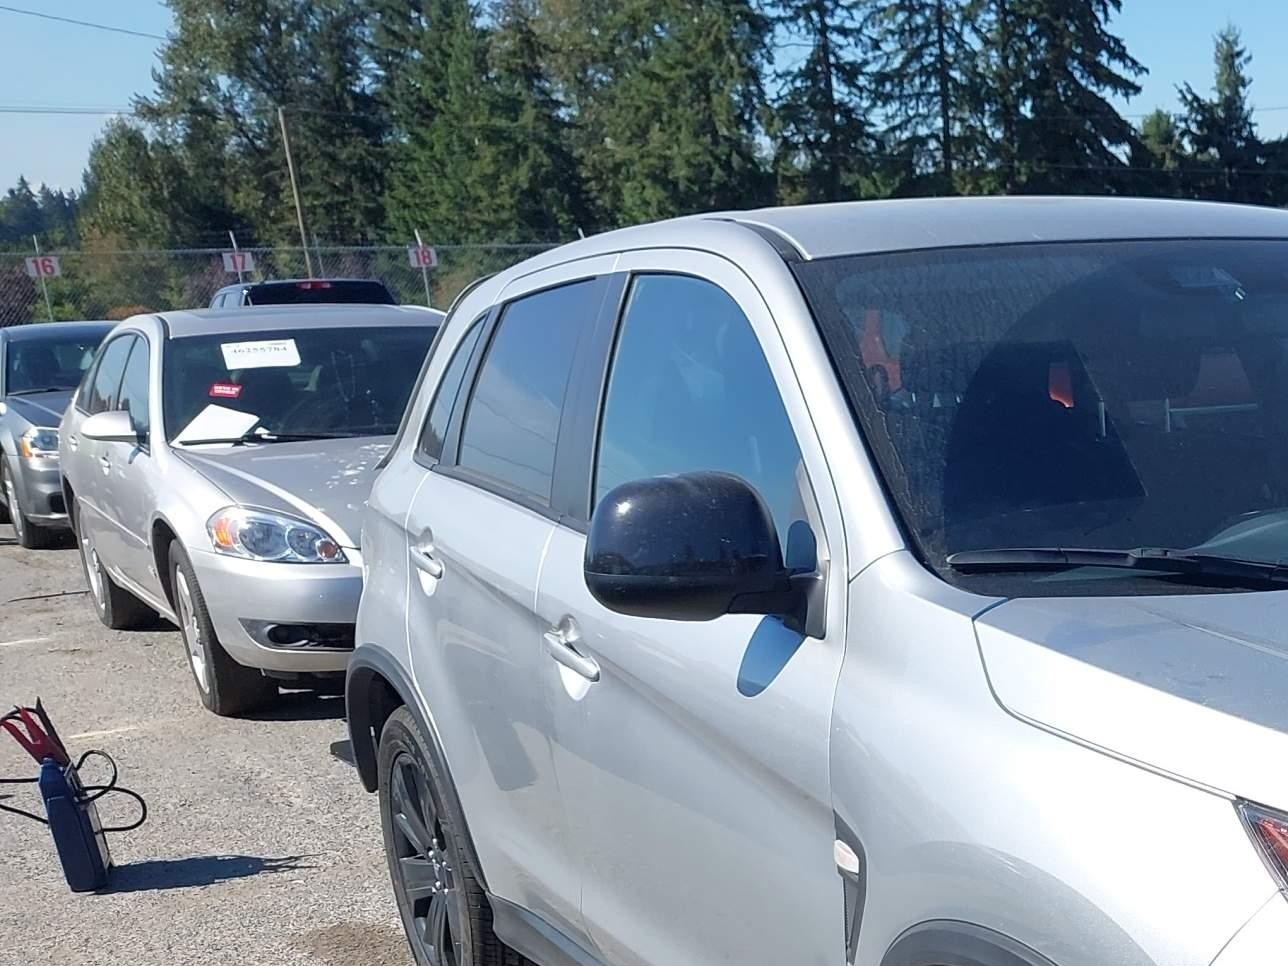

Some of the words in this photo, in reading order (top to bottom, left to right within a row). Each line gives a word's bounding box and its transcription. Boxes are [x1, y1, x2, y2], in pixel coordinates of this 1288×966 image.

[230, 254, 246, 271] 17
[413, 248, 433, 266] 18
[32, 258, 55, 276] 16
